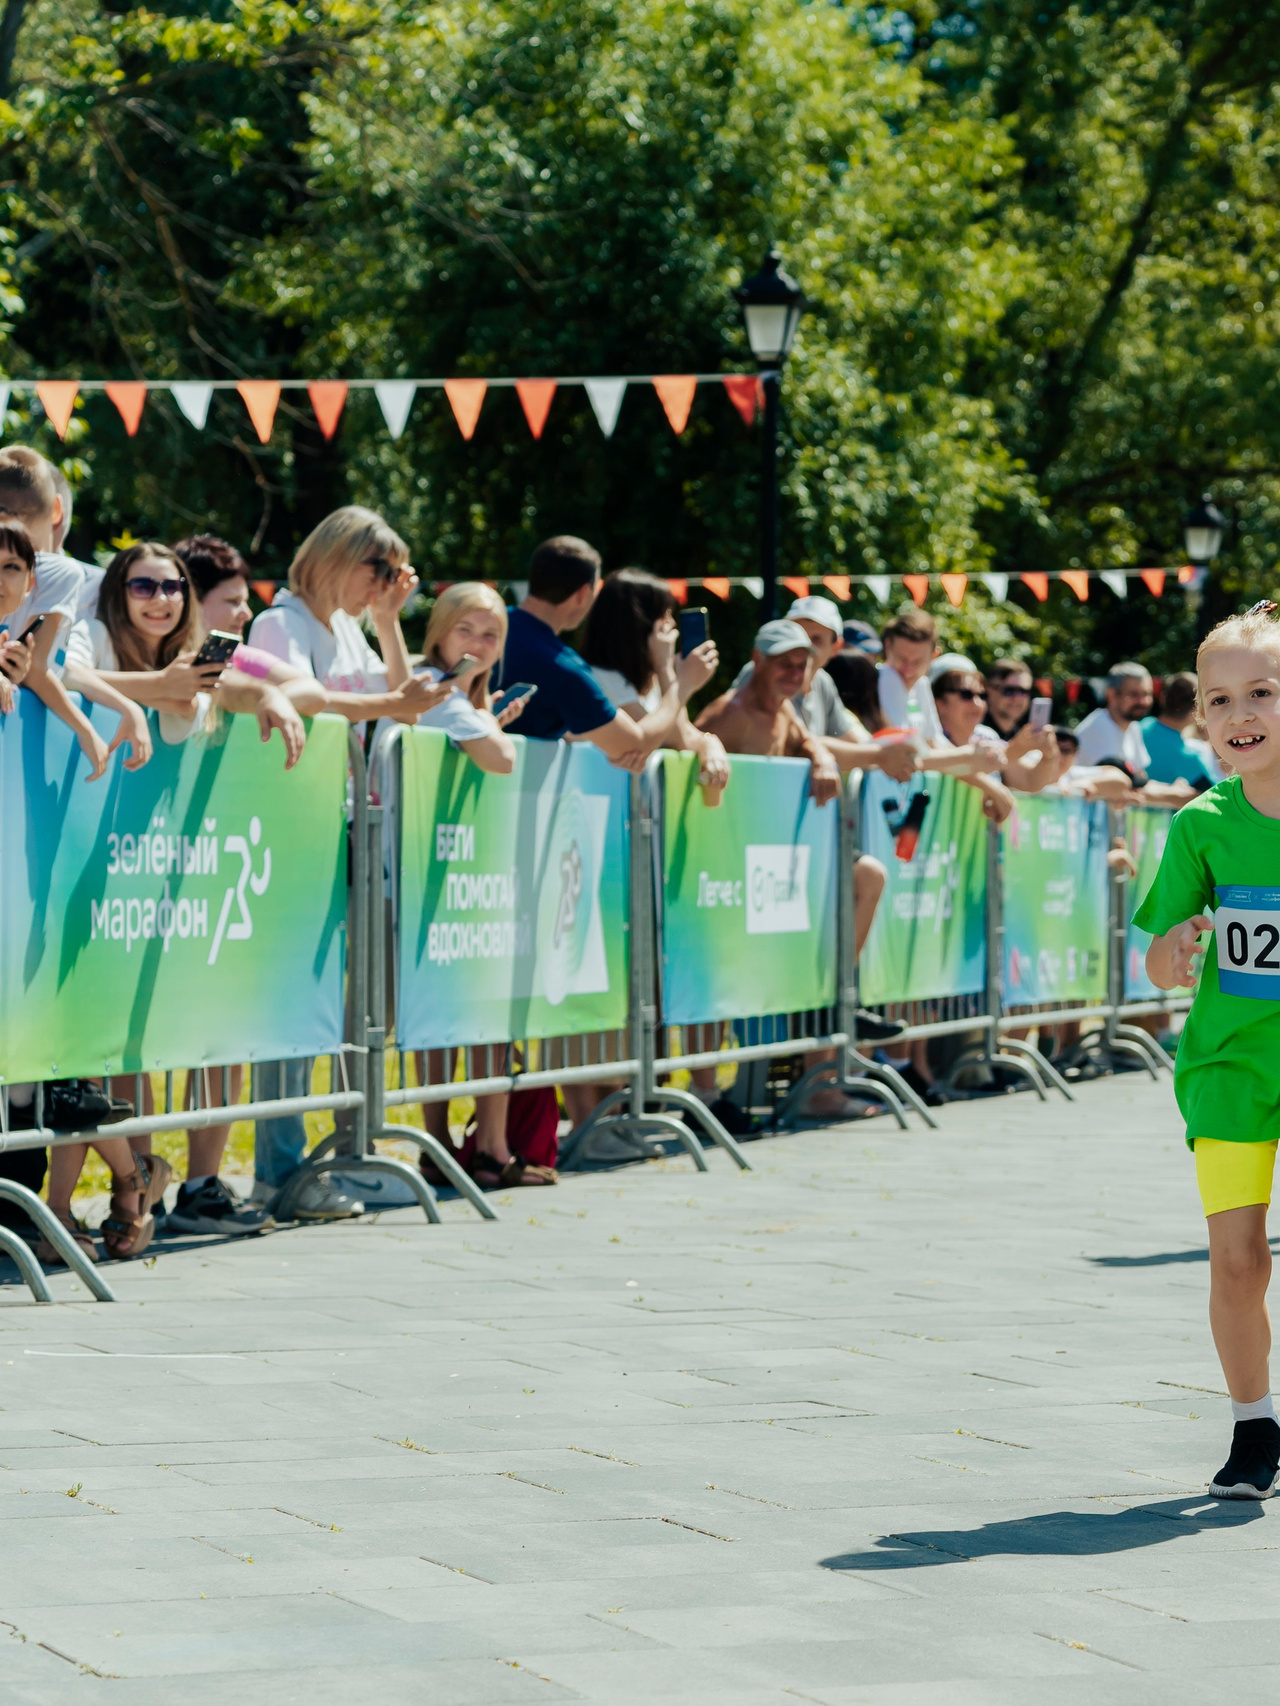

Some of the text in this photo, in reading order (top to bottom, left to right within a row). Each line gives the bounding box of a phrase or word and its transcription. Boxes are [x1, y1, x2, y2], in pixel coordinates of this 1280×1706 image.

[107, 816, 218, 875] зелёный
[436, 823, 475, 862] БЕГИ
[446, 866, 521, 911] ПОМОГАЙ
[91, 880, 208, 953] марафон
